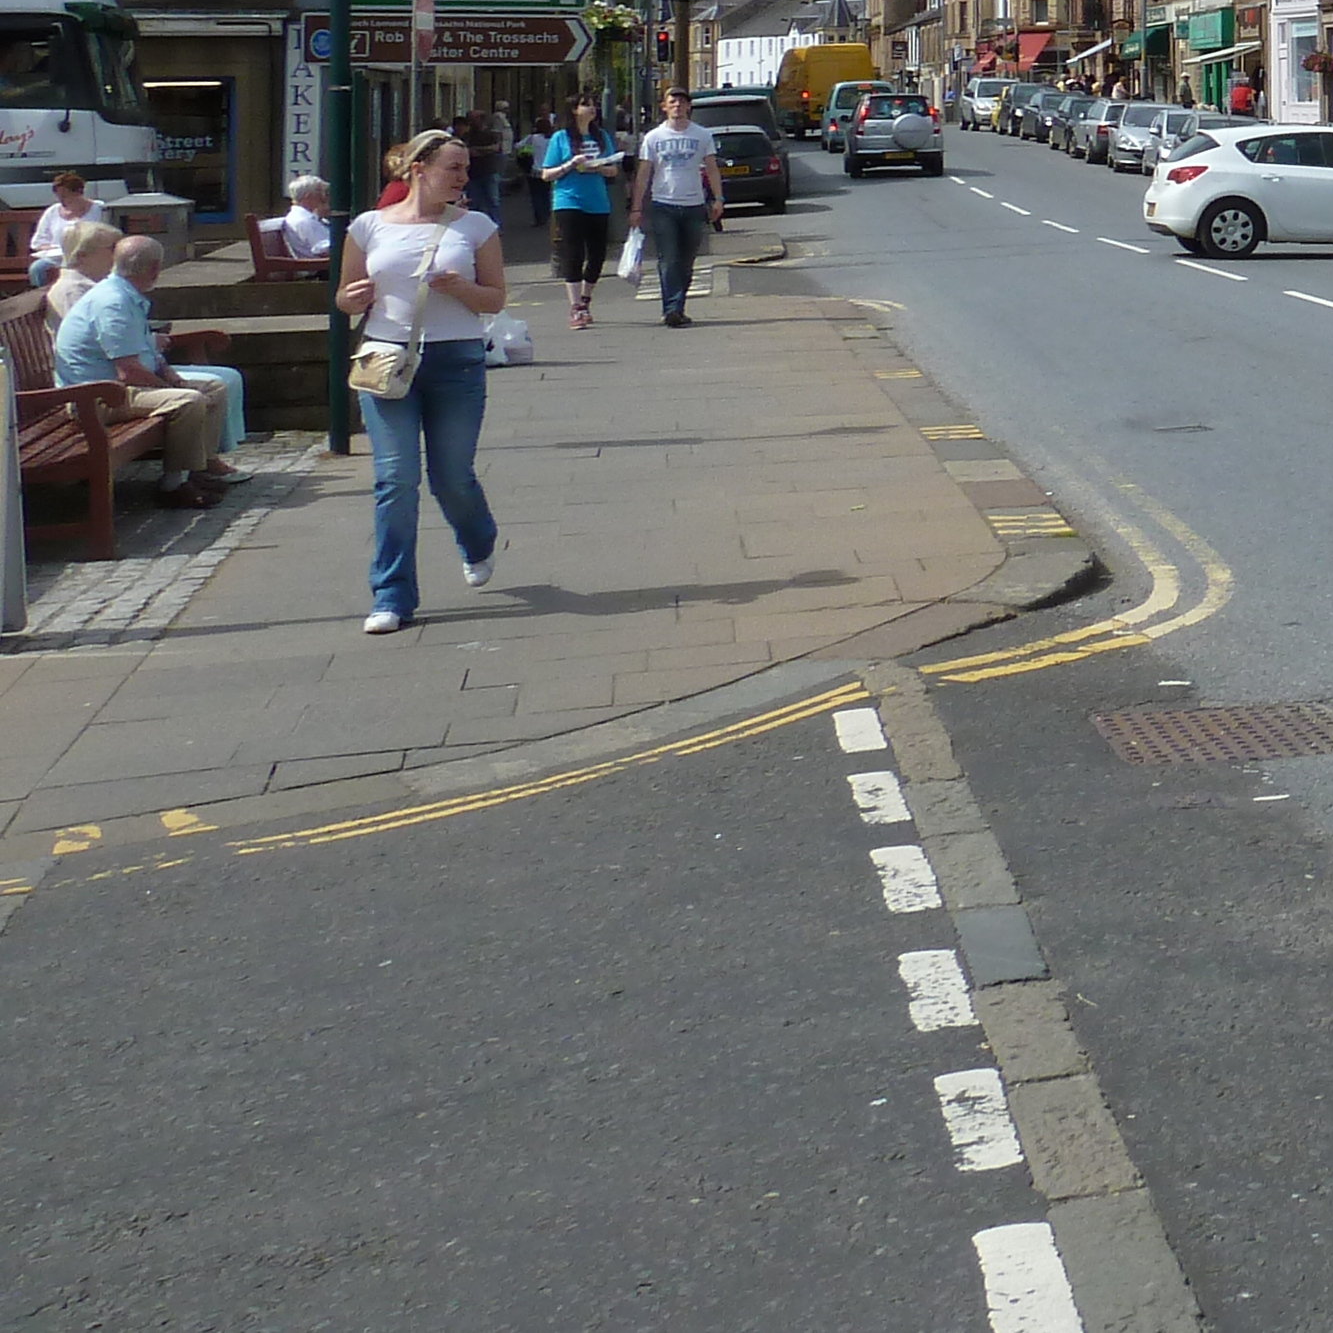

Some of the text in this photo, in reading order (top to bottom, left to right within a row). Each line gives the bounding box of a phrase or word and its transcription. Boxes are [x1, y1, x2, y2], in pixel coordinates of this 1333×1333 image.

[374, 30, 404, 43] Rob
[459, 31, 485, 44] The
[489, 32, 559, 44] Trossachs
[469, 47, 520, 59] Centre
